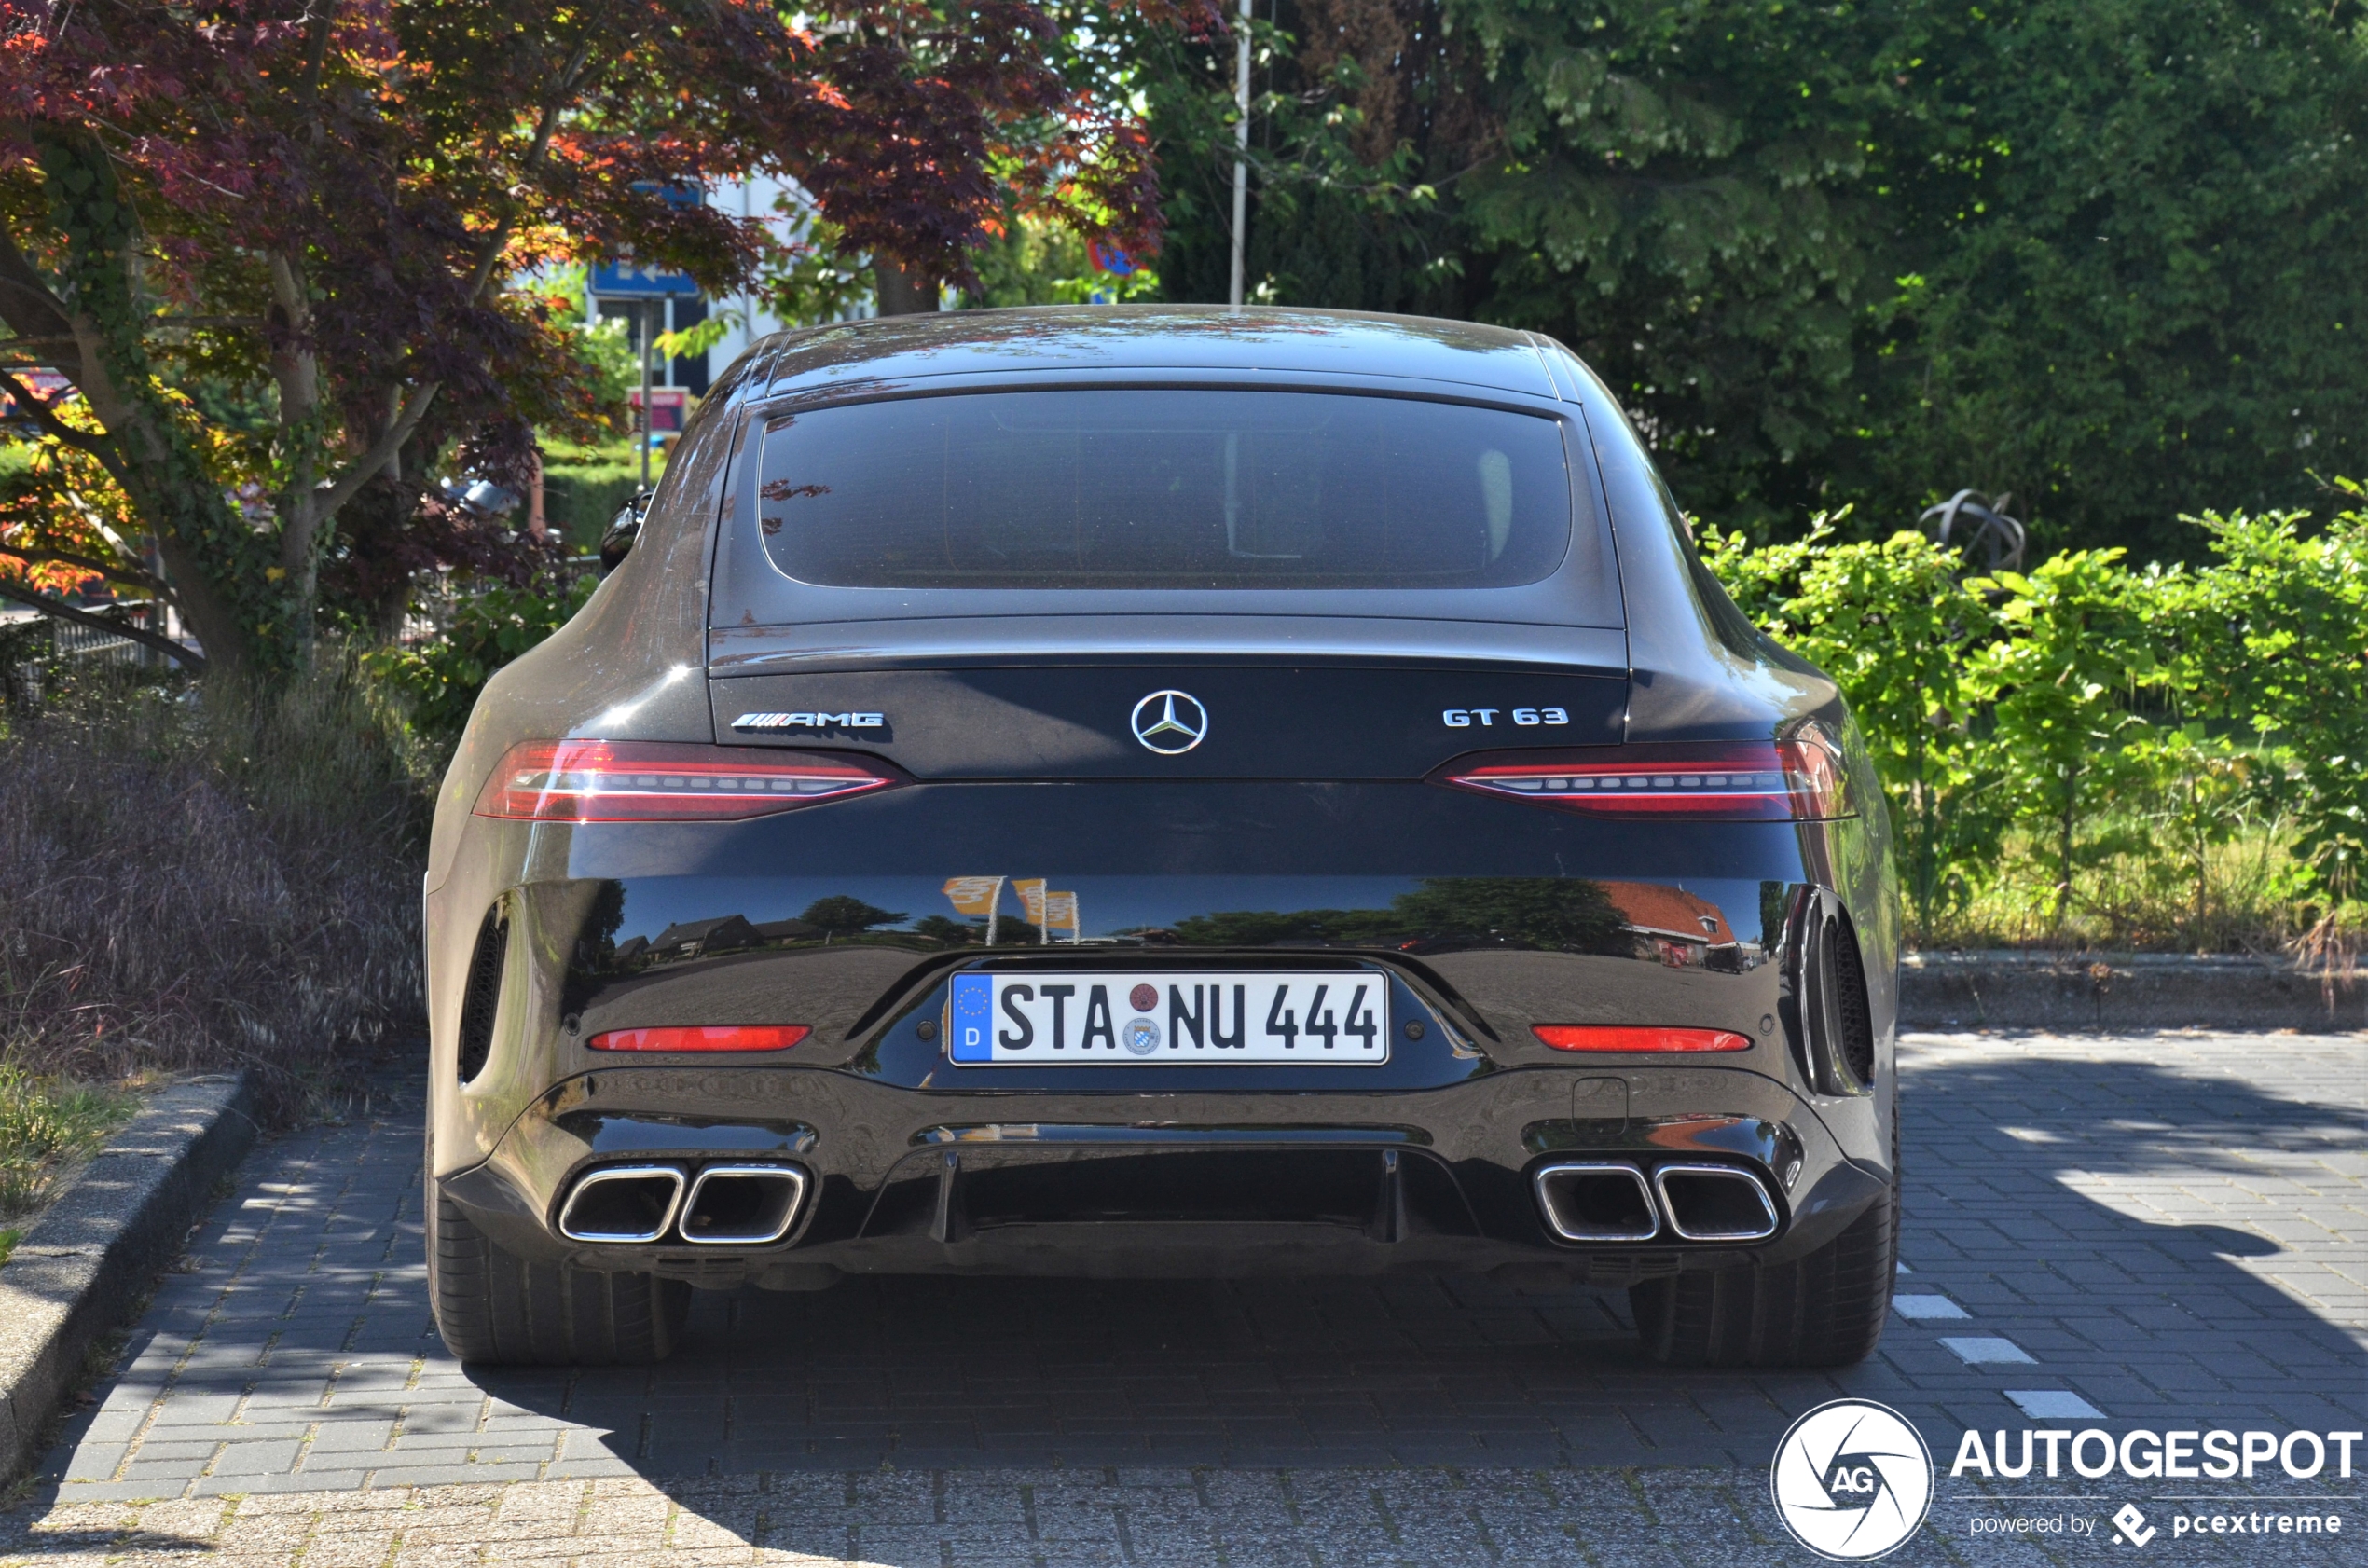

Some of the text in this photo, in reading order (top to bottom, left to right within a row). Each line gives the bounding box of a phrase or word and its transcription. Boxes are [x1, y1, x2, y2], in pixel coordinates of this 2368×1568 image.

[1443, 708, 1569, 727] GT 63
[998, 984, 1377, 1051] STA NU 444
[966, 1027, 980, 1046] D
